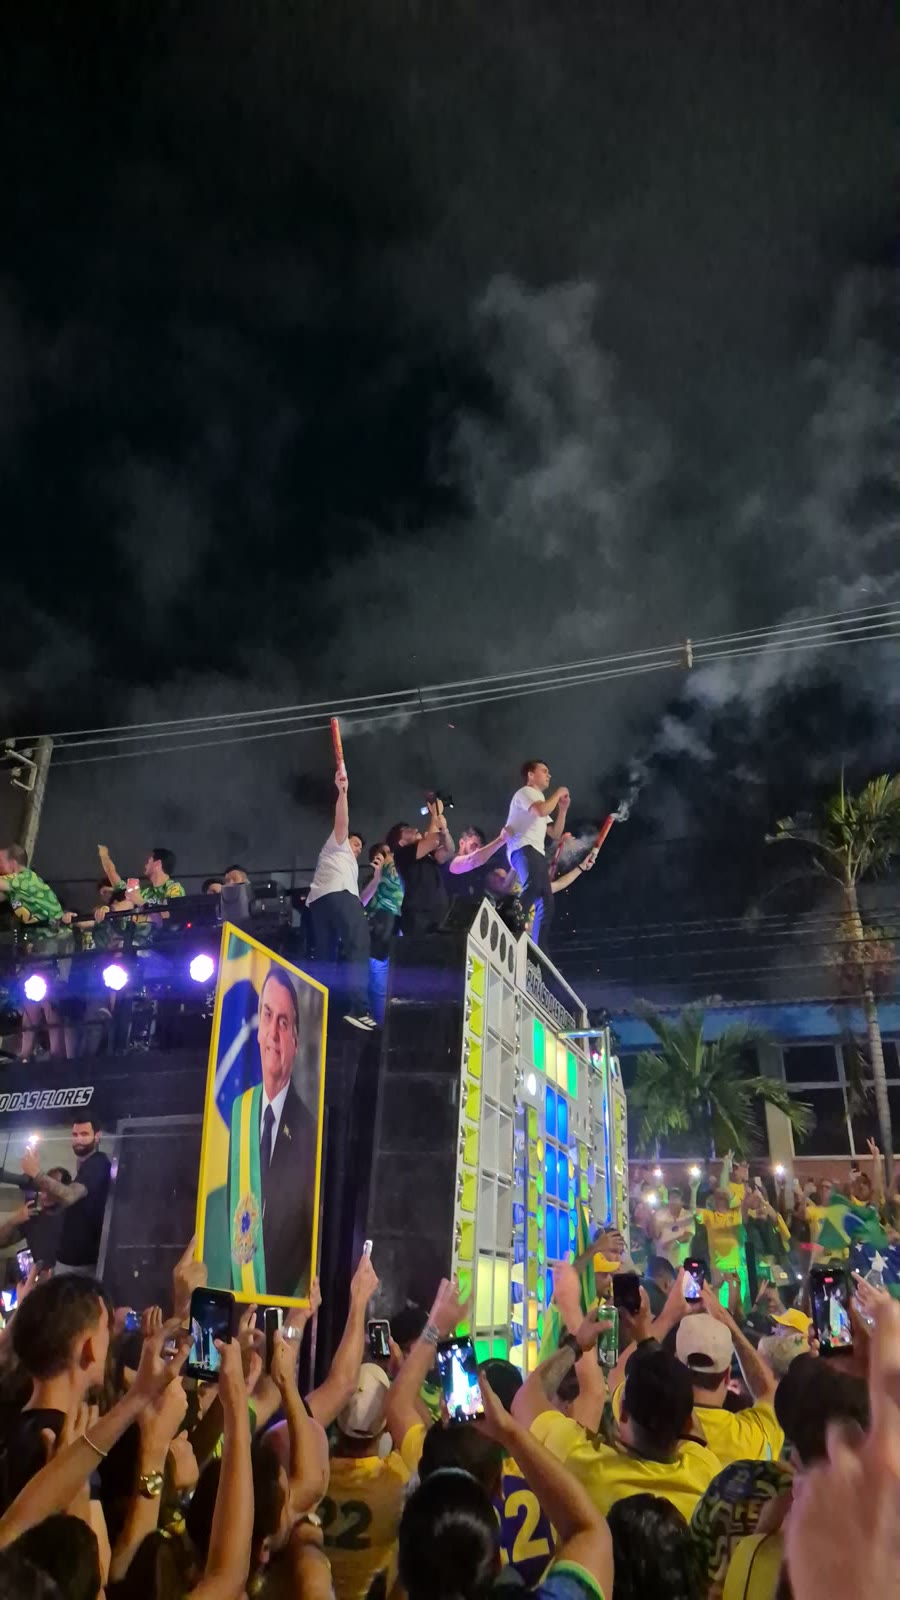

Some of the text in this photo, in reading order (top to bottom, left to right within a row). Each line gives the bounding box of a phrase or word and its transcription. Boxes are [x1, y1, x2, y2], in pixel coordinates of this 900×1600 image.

[7, 1091, 40, 1111] DAS
[37, 1086, 94, 1109] FLORES
[315, 1496, 372, 1551] 22
[496, 1490, 550, 1562] 2
